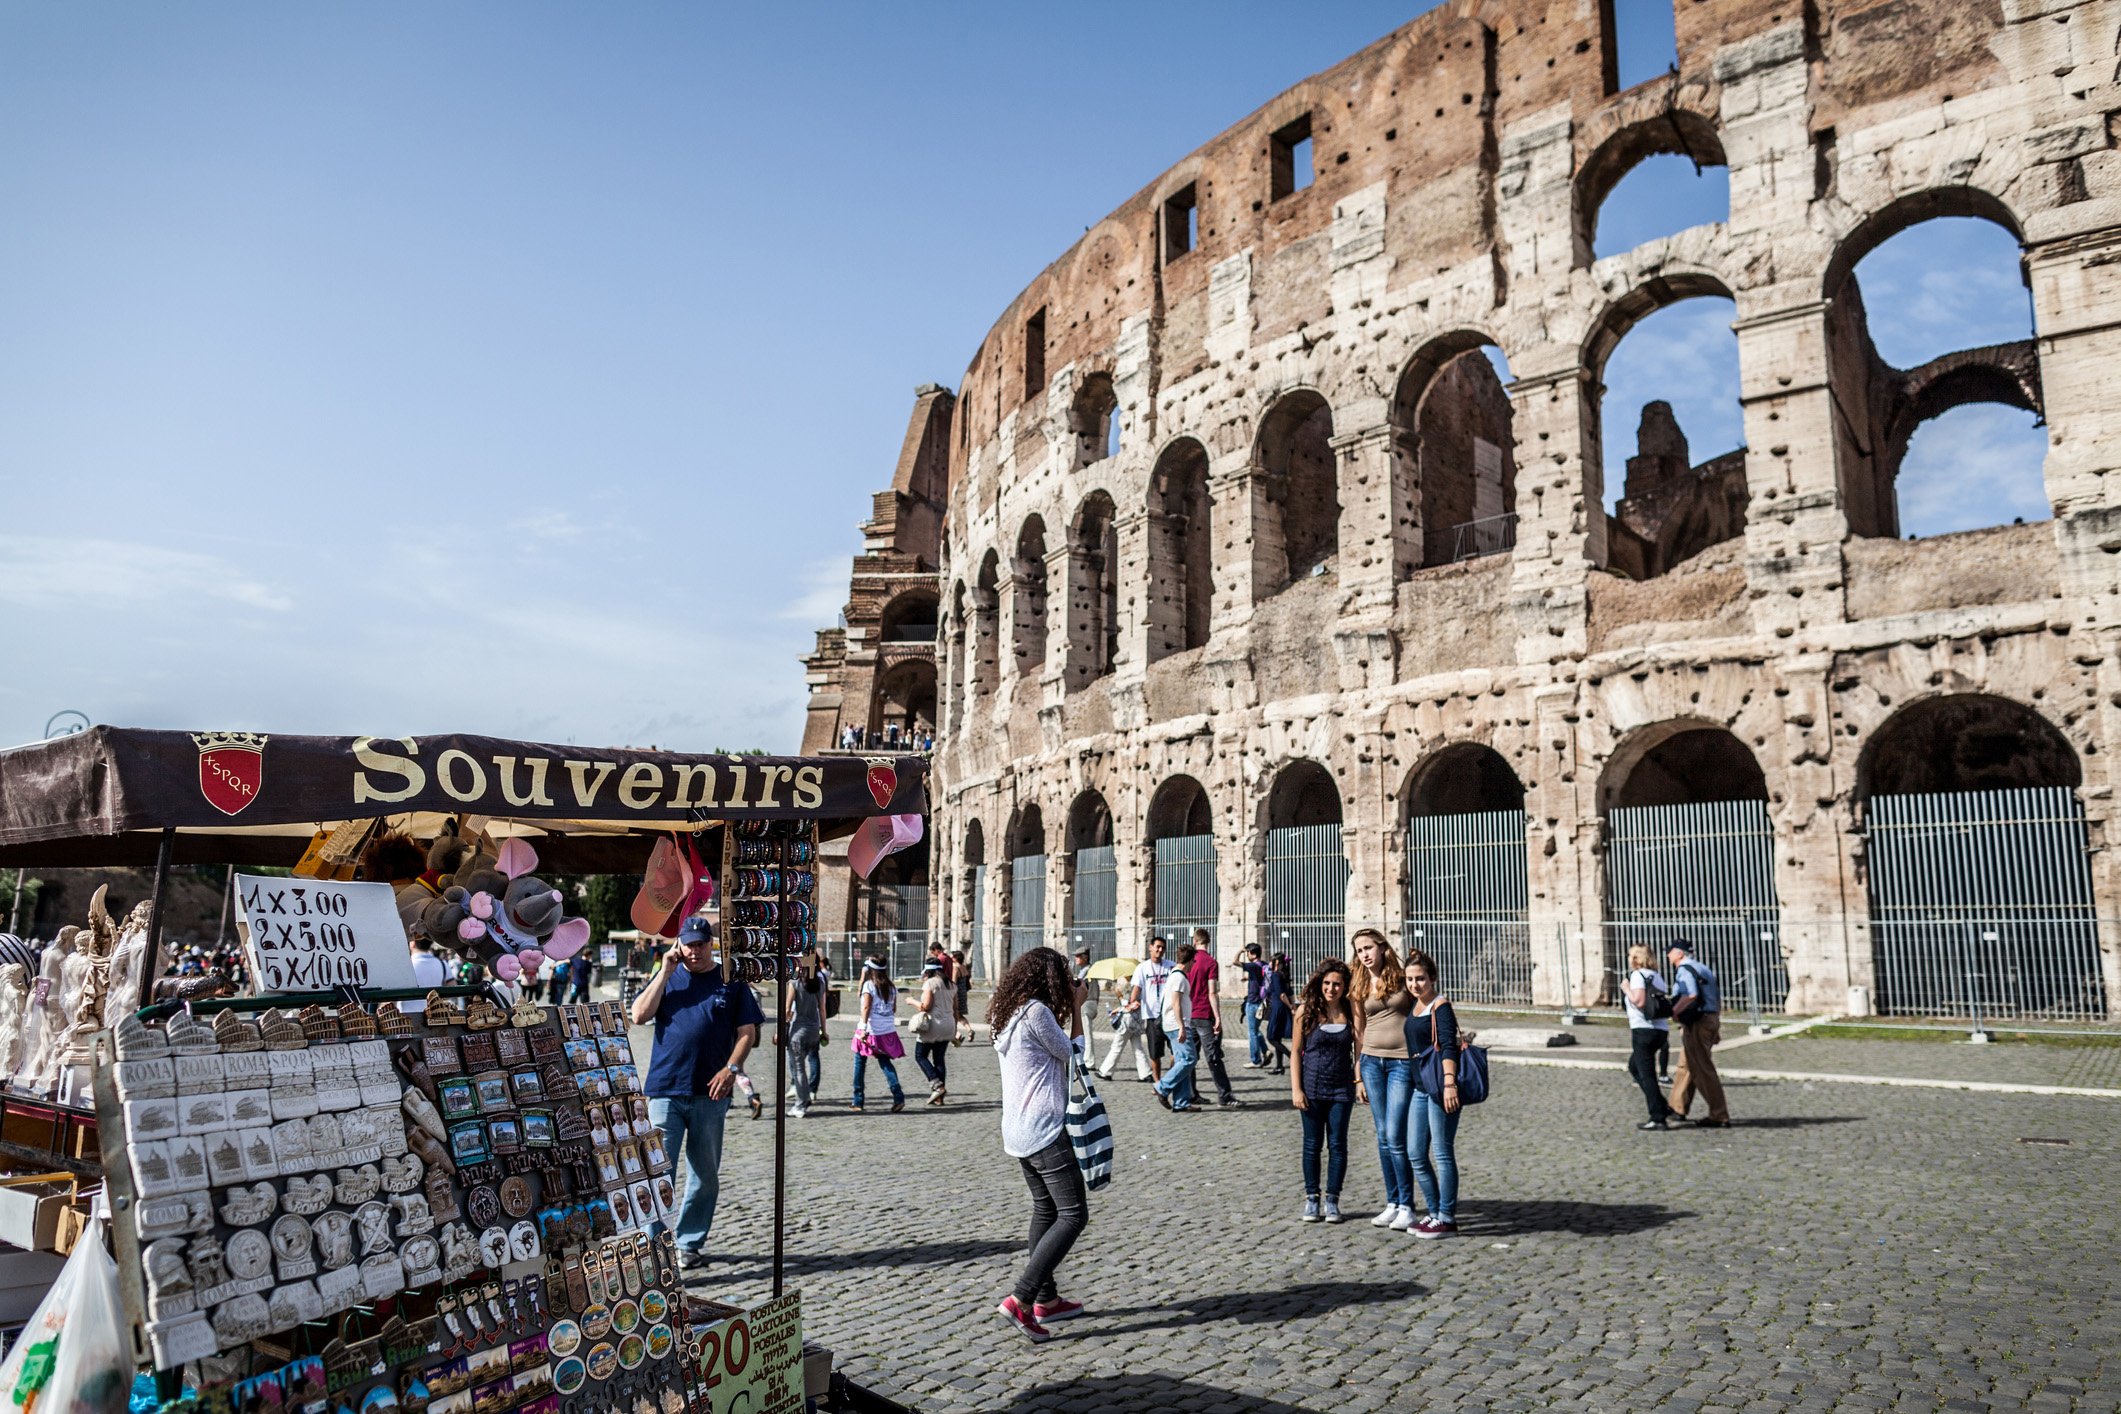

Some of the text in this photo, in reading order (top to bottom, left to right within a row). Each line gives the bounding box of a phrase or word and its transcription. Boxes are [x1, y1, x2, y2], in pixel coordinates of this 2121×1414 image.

[212, 762, 253, 796] SPQR
[353, 736, 824, 810] Souvenirs
[721, 907, 730, 959] ITALY
[124, 1061, 173, 1083] ROMA
[180, 1059, 222, 1080] ROMA
[228, 1055, 268, 1073] ROMA
[349, 1146, 380, 1162] ROMA
[508, 1151, 551, 1175] ROMA
[551, 1145, 591, 1166] ROMA
[281, 1157, 315, 1173] ROMA
[389, 1178, 419, 1192] ROMA
[294, 1200, 326, 1214] ROMA
[344, 1189, 376, 1204] ROMA
[280, 1263, 316, 1279] ROMA
[413, 1268, 441, 1287] ROMA
[749, 1291, 800, 1323] POSTCARDS
[750, 1306, 800, 1338] CARTOLINE
[753, 1324, 796, 1354] POSTALES
[699, 1319, 750, 1391] 20
